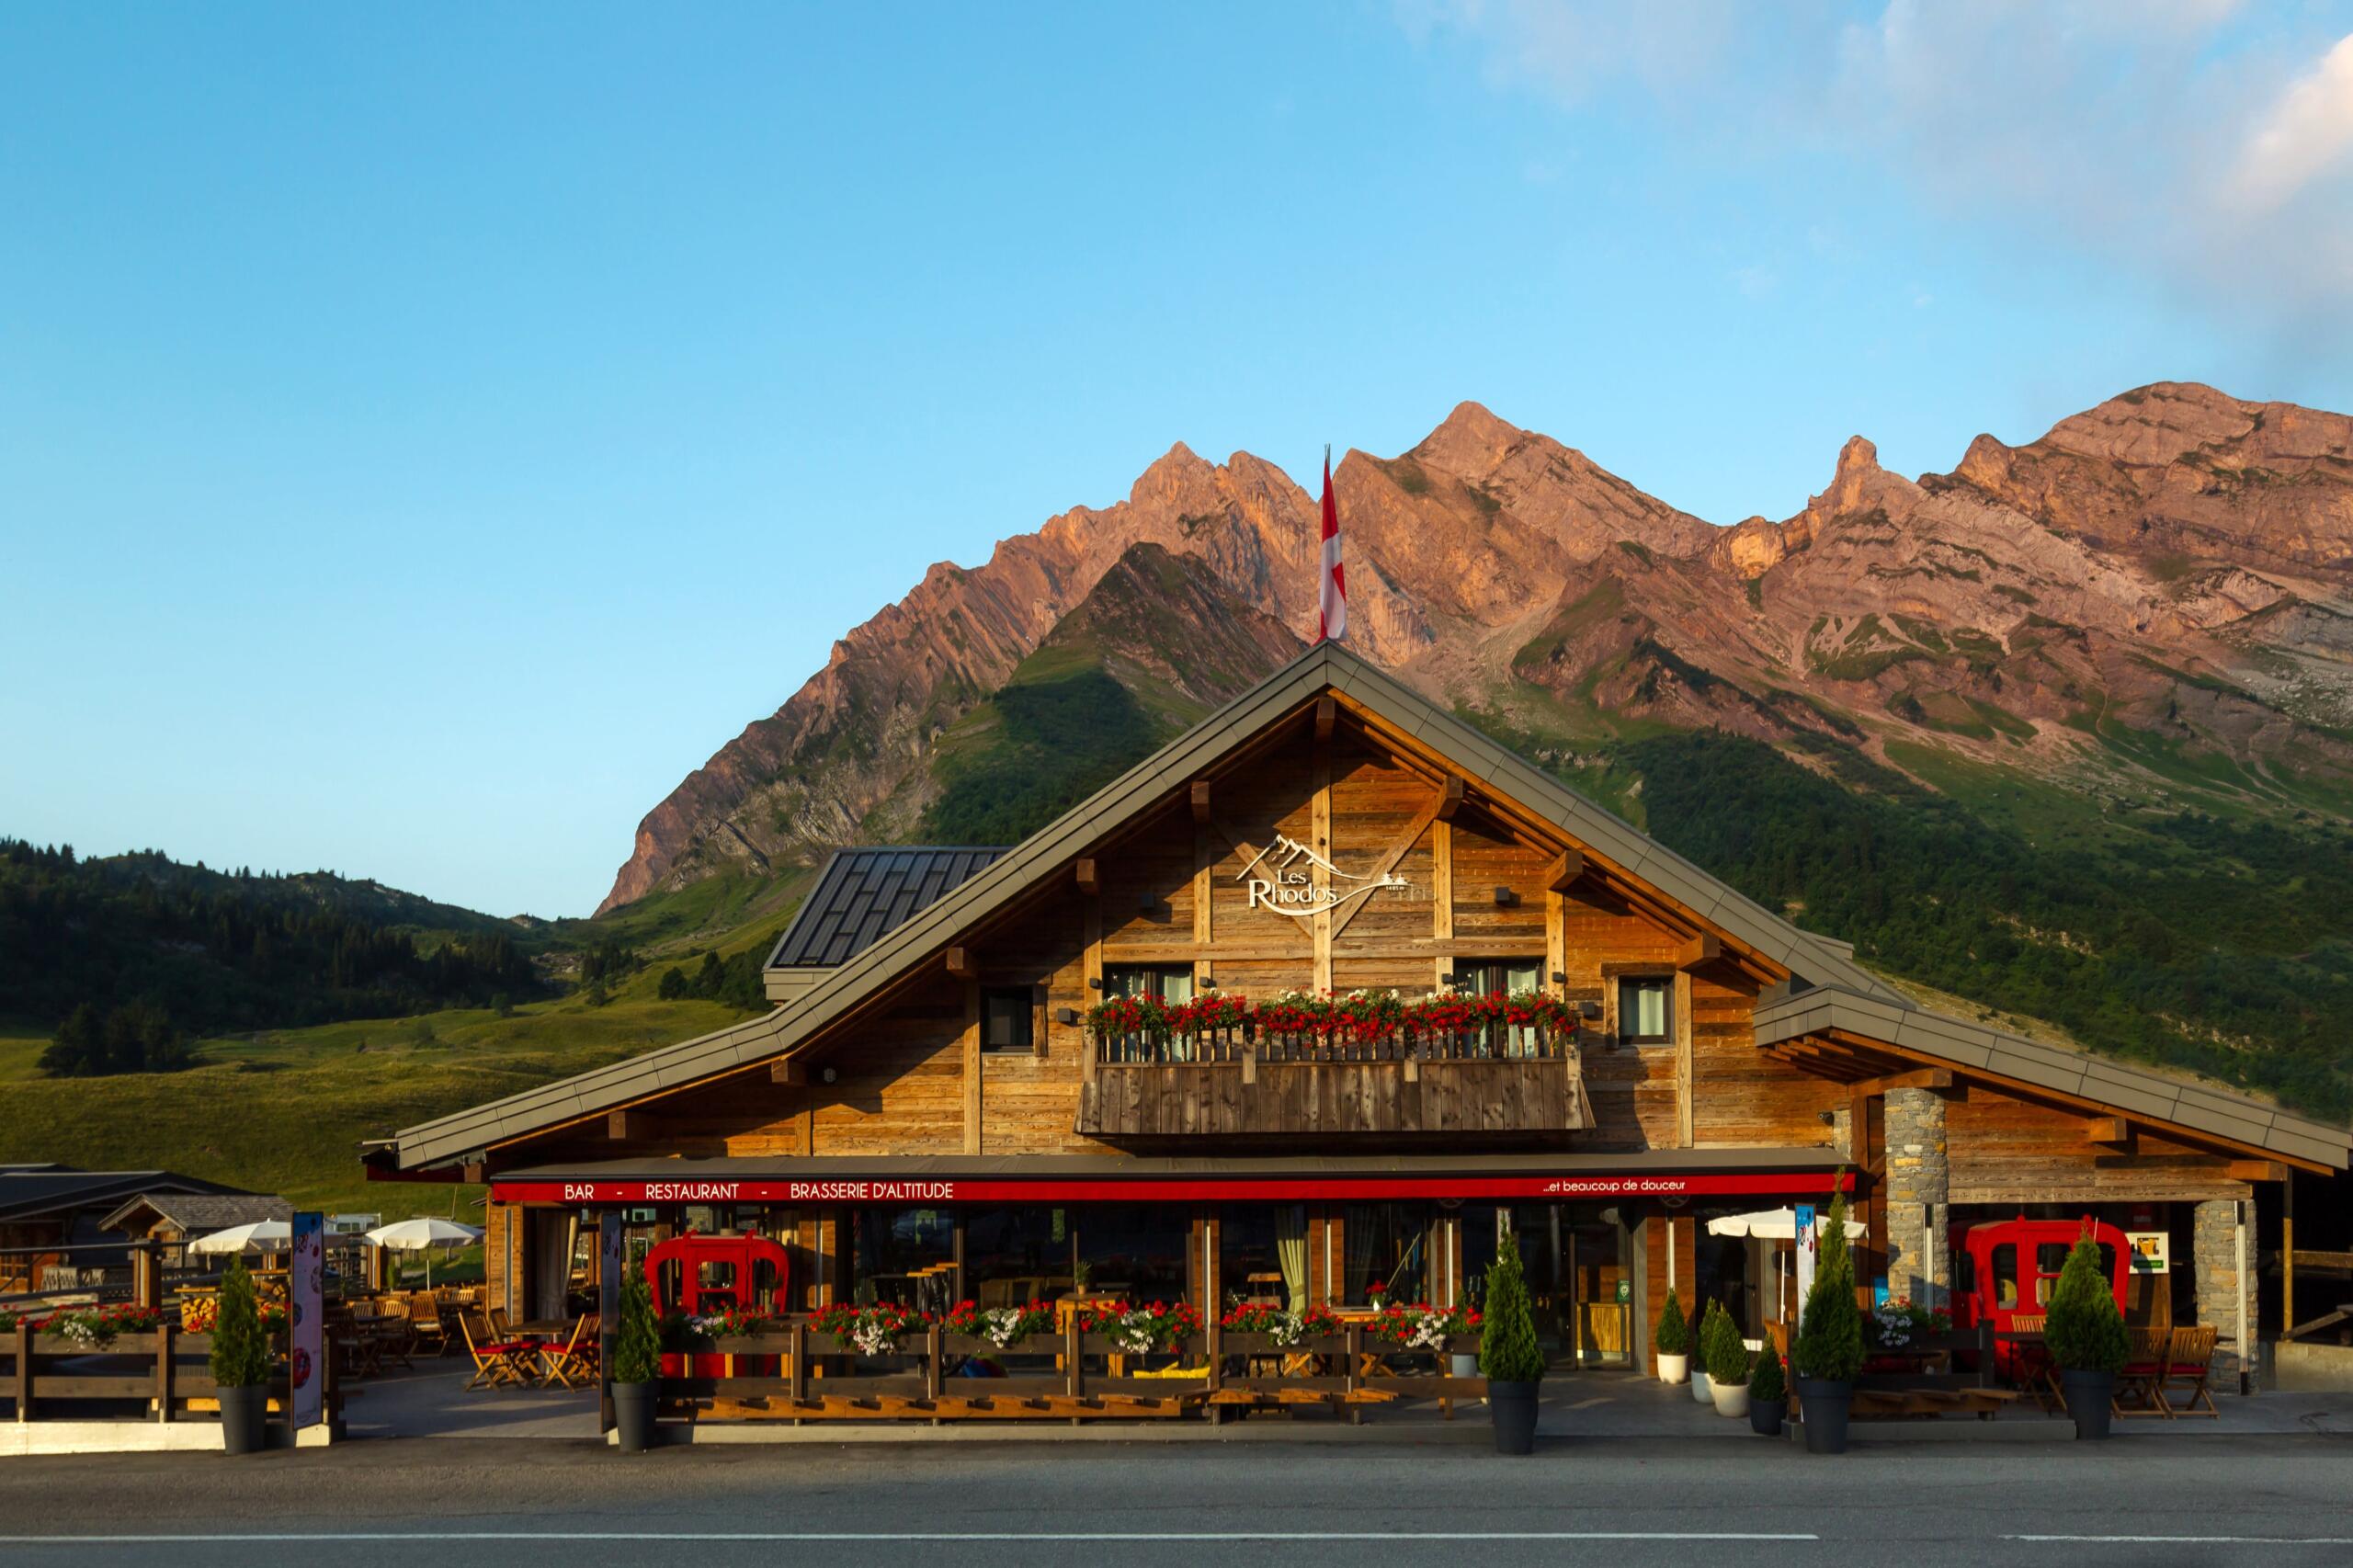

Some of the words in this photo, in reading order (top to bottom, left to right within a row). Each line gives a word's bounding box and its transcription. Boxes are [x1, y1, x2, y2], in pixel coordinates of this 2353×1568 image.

[1278, 869, 1307, 884] Les
[1248, 879, 1339, 908] Rhodos
[564, 1184, 594, 1199] BAR
[645, 1183, 740, 1199] RESTAURANT
[790, 1183, 869, 1199] BRASSERIE
[872, 1183, 954, 1199] D'ALTITUDE
[1563, 1180, 1620, 1193] beaucoup
[1622, 1179, 1638, 1191] de
[1641, 1179, 1686, 1191] douceur
